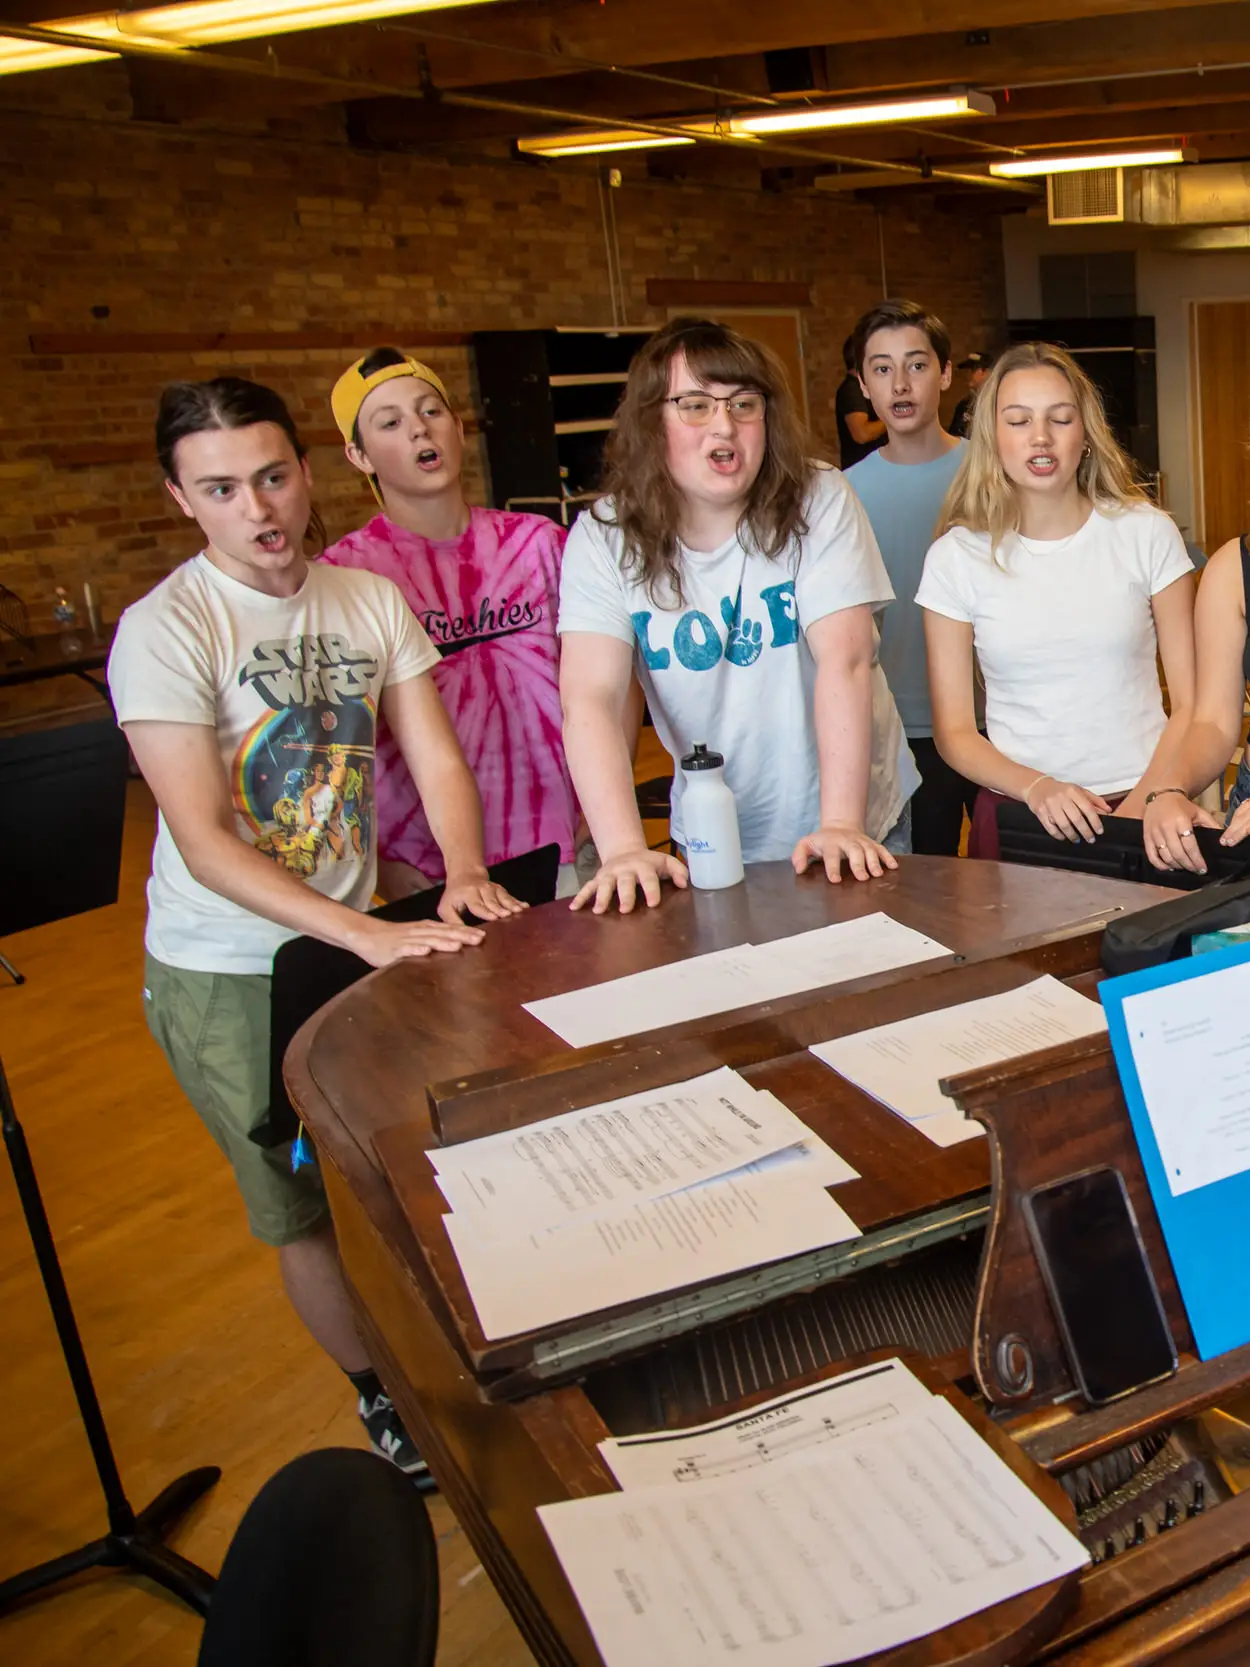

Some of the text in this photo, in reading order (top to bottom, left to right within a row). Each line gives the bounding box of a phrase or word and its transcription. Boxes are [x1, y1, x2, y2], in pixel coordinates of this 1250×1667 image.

[420, 597, 542, 641] Freshies
[239, 633, 377, 686] STAR
[251, 664, 378, 710] WARS
[736, 1413, 773, 1430] SANTA
[775, 1407, 789, 1416] FE
